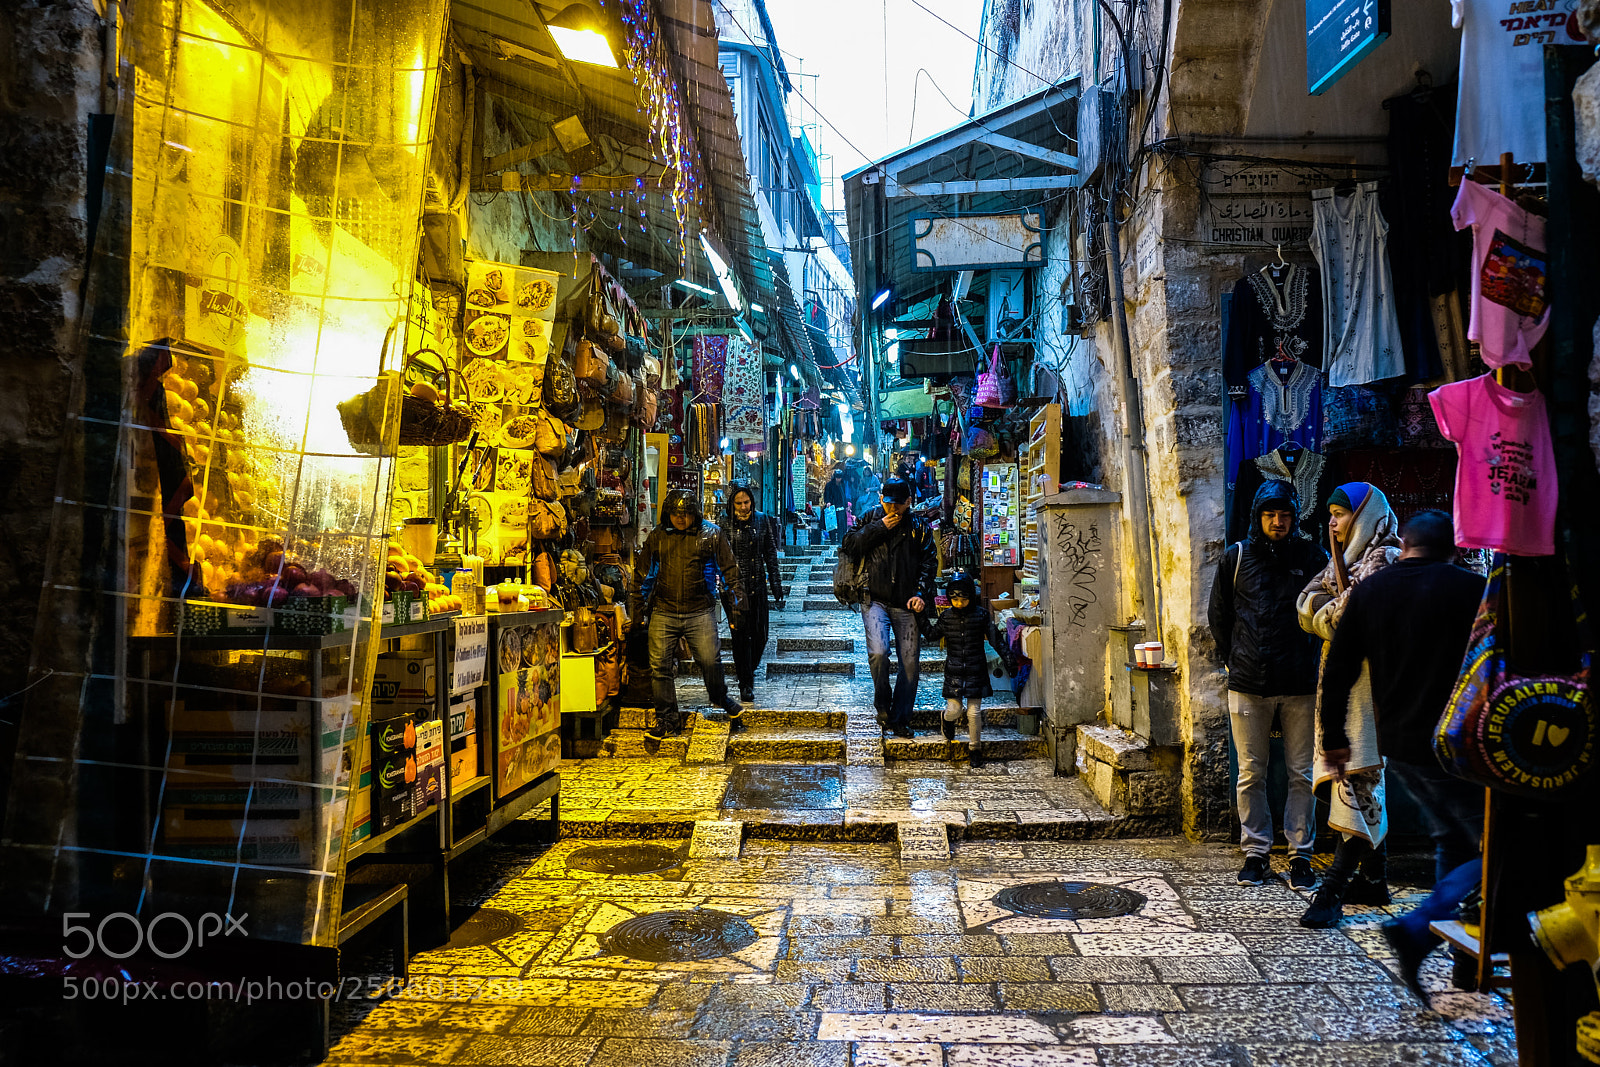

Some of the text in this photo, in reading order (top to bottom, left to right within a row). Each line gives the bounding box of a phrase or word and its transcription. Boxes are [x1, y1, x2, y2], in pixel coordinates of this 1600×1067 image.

[1509, 0, 1556, 15] HEAT
[1500, 12, 1567, 32] מיאמי
[1513, 30, 1556, 47] היט
[1212, 227, 1263, 242] CHRISTIAN
[1488, 682, 1559, 744] JERUSALEM
[1531, 719, 1549, 747] I
[1492, 749, 1580, 790] JERUSALEM
